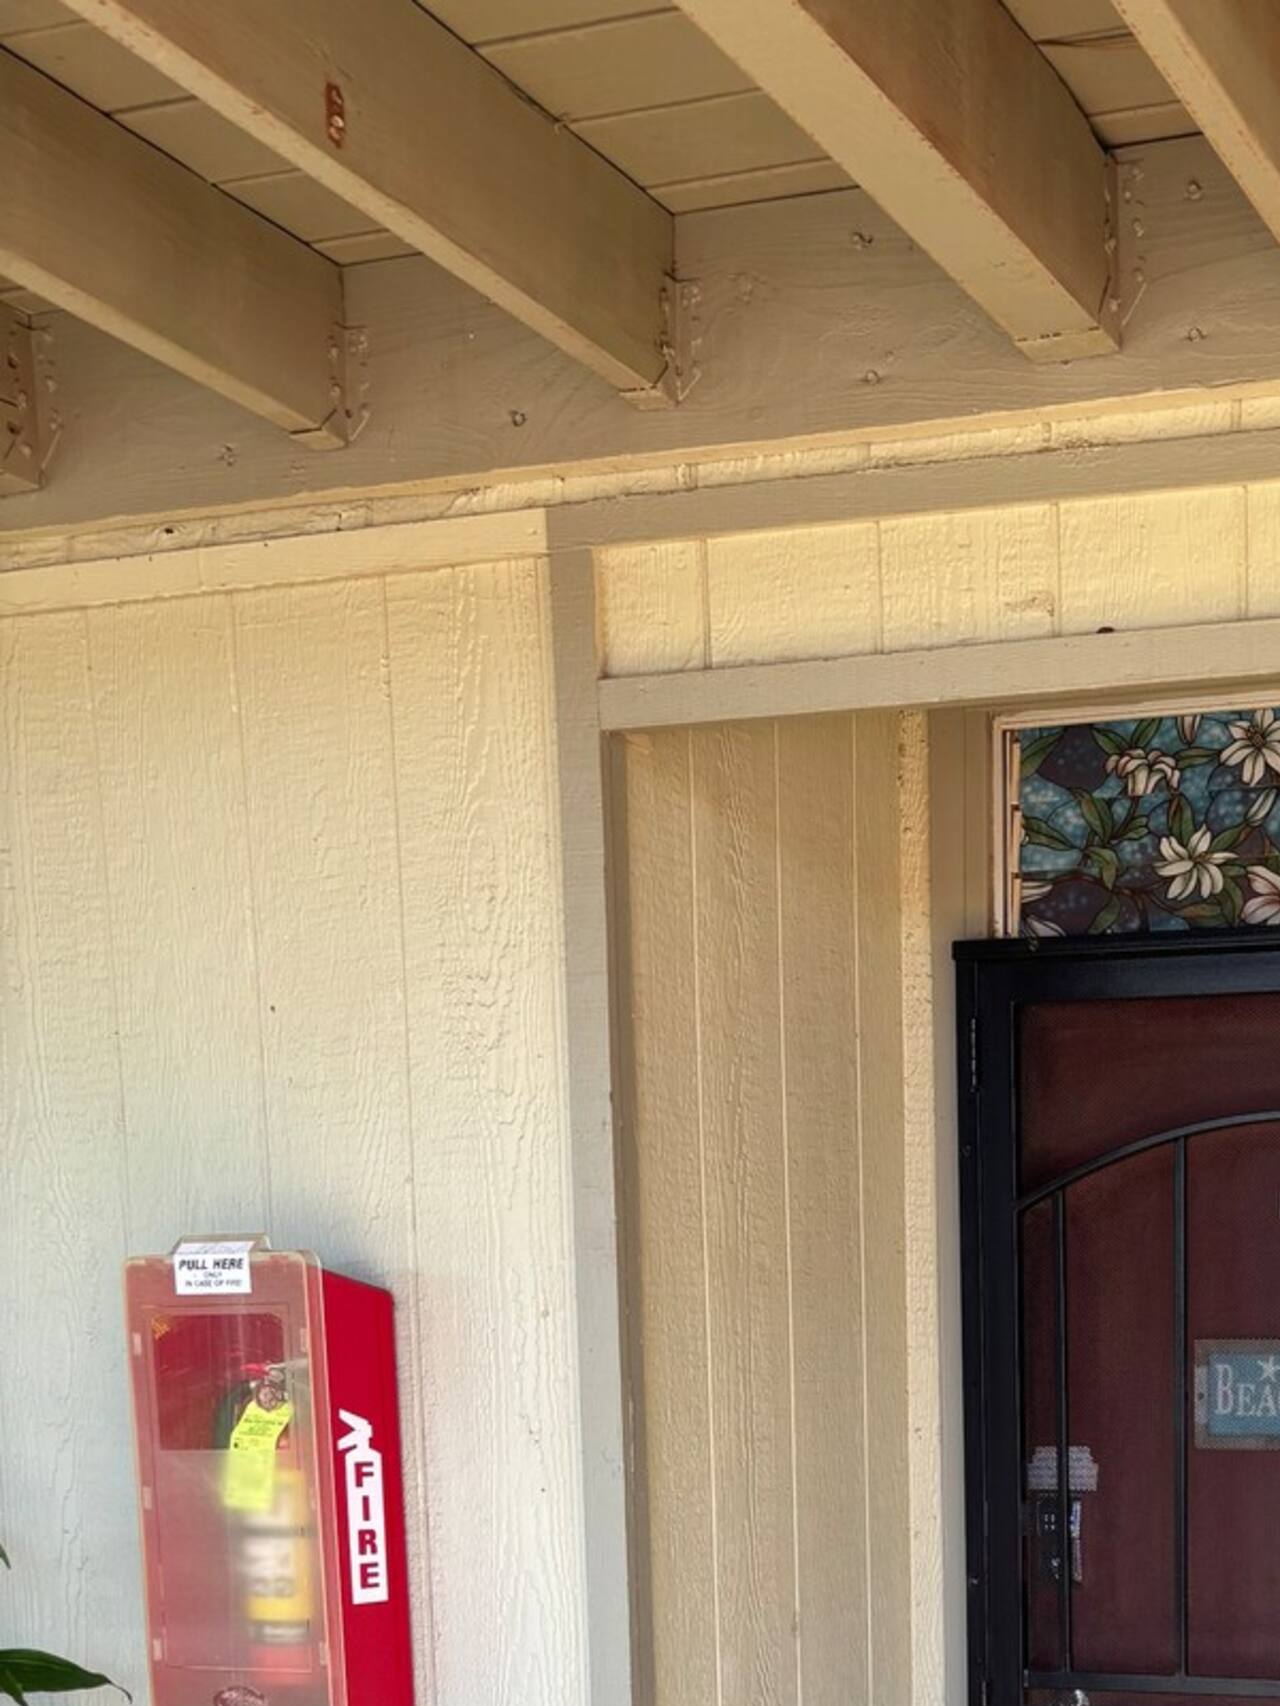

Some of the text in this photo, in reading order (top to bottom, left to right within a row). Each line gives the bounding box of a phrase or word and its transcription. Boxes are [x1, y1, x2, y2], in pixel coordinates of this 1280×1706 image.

[178, 1258, 244, 1271] PULL HERE
[353, 1461, 381, 1590] FIRE
